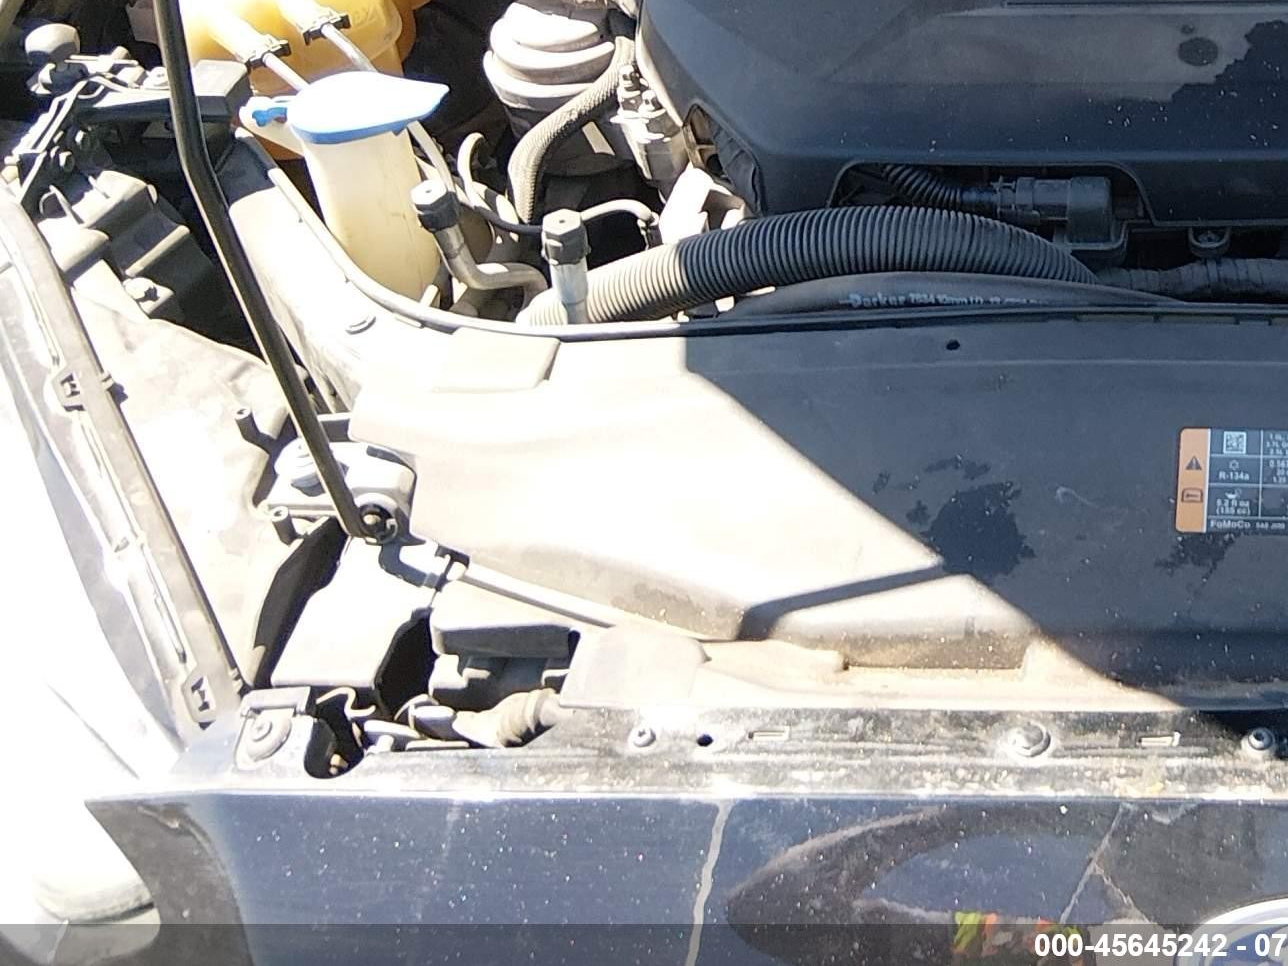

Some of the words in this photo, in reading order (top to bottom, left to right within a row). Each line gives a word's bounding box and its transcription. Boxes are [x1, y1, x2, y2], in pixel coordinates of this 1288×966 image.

[849, 293, 905, 308] Parker
[1218, 471, 1250, 481] R-134a
[1210, 520, 1251, 529] FoMoCo
